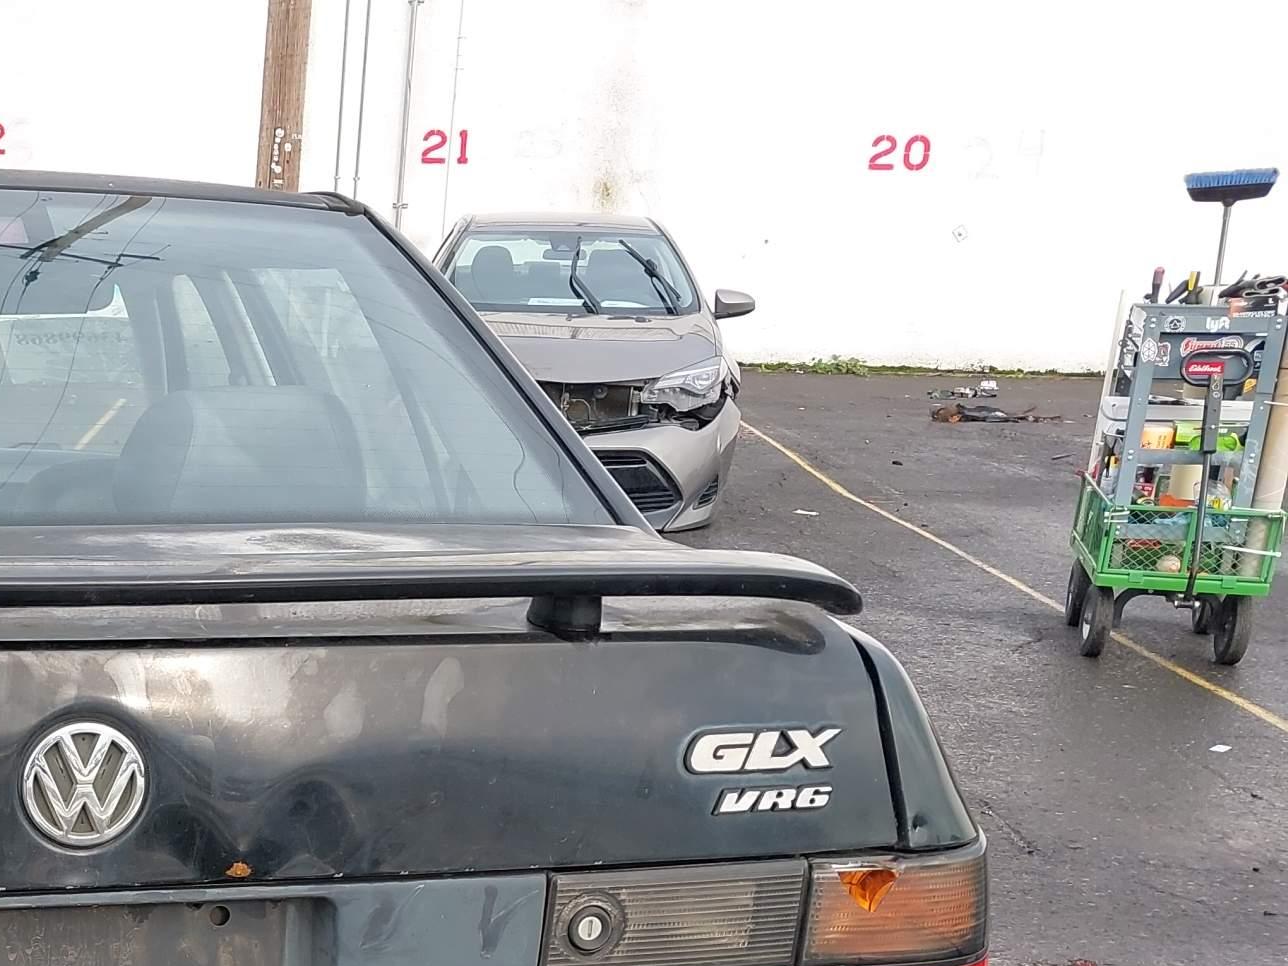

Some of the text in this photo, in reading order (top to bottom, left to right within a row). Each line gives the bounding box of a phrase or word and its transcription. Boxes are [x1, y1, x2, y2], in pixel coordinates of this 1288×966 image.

[421, 129, 468, 164] 21
[868, 134, 931, 171] 20
[688, 728, 844, 773] GLX
[716, 784, 833, 814] VR6
